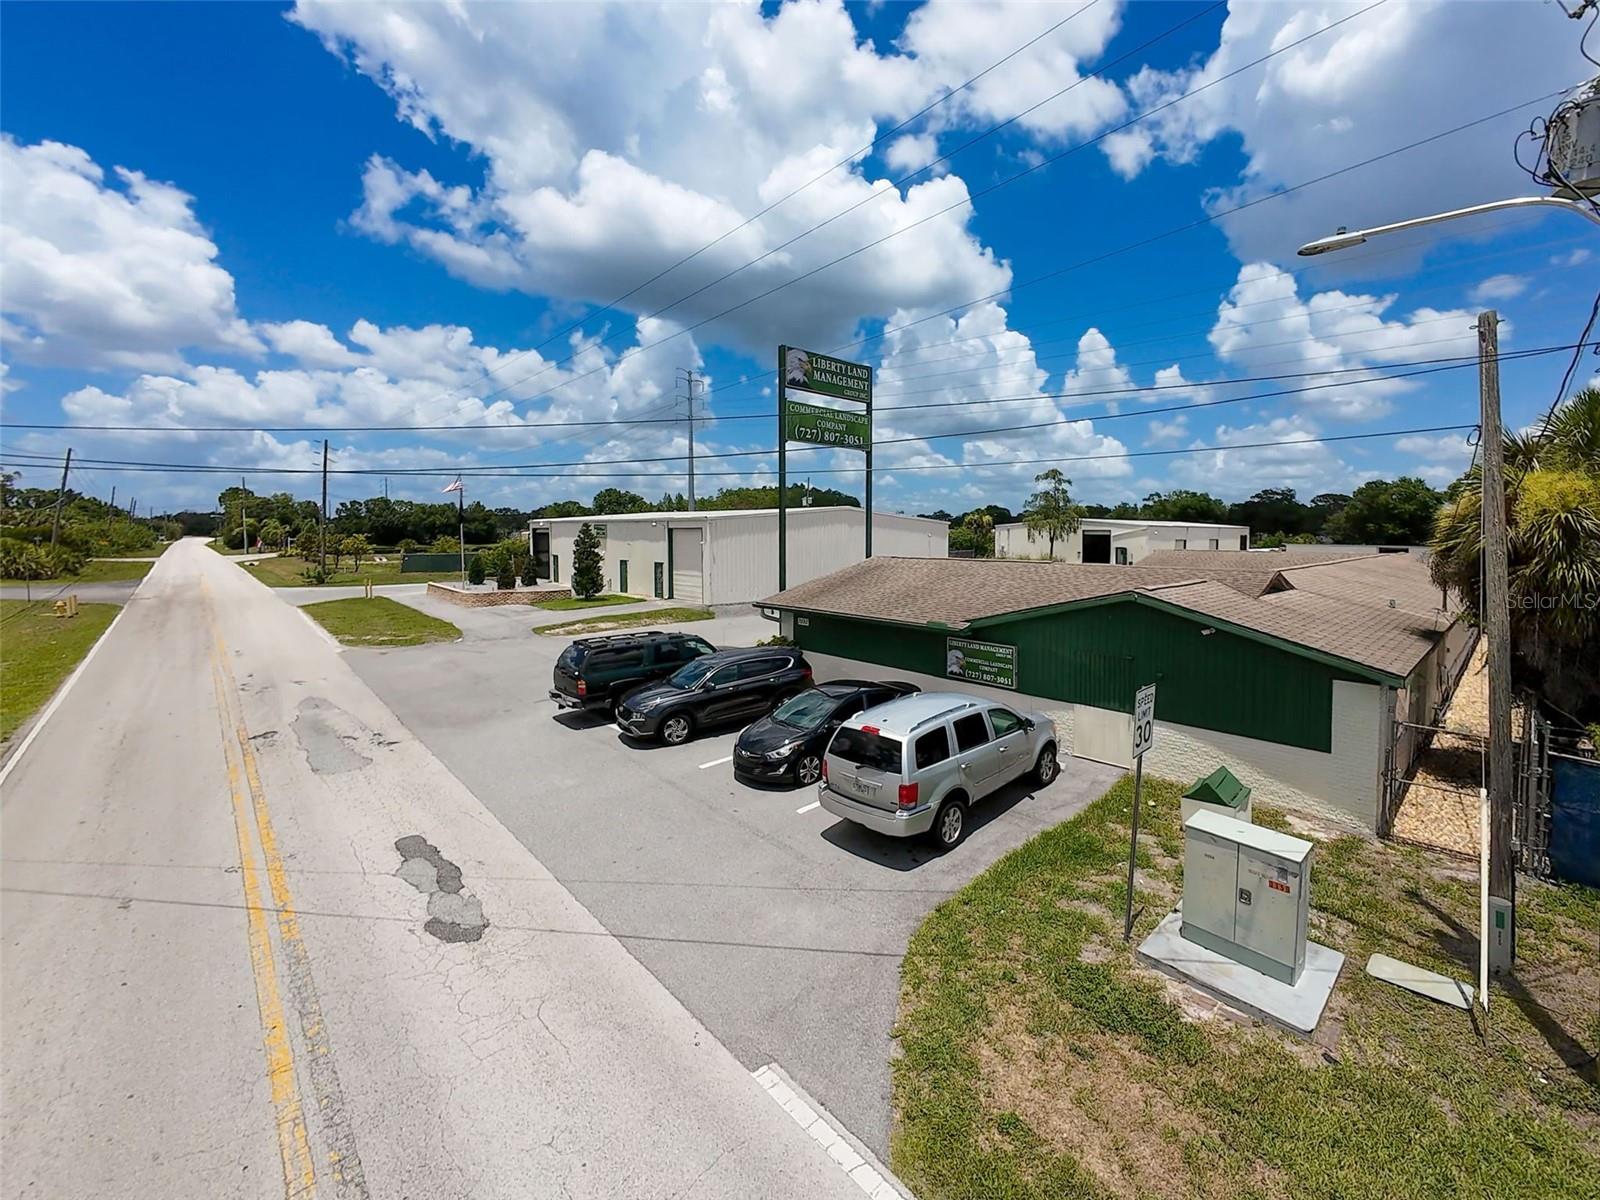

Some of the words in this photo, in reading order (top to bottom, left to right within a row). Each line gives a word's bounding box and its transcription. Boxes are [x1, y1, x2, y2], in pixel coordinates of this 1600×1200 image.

[812, 357, 847, 374] LIBERTY
[847, 365, 868, 379] LAND
[813, 371, 869, 391] MANAGEMENT
[789, 403, 834, 419] COMMERCIAL
[834, 411, 869, 425] LANDSCAPE
[816, 420, 847, 431] COMPANY
[795, 424, 821, 442] (727)
[824, 432, 863, 445] 807-3051
[949, 640, 967, 648] LIBERTY
[980, 644, 1013, 655] MANAGEMENT
[964, 657, 989, 666] COMMERCIAL
[989, 660, 1013, 670] LANDSCAPE
[979, 665, 998, 673] COMPANY
[965, 669, 982, 680] (727)
[983, 674, 1012, 685] 807-3051
[1137, 692, 1154, 709] SPEED
[1137, 706, 1152, 722] LIMIT
[1135, 720, 1151, 748] 30
